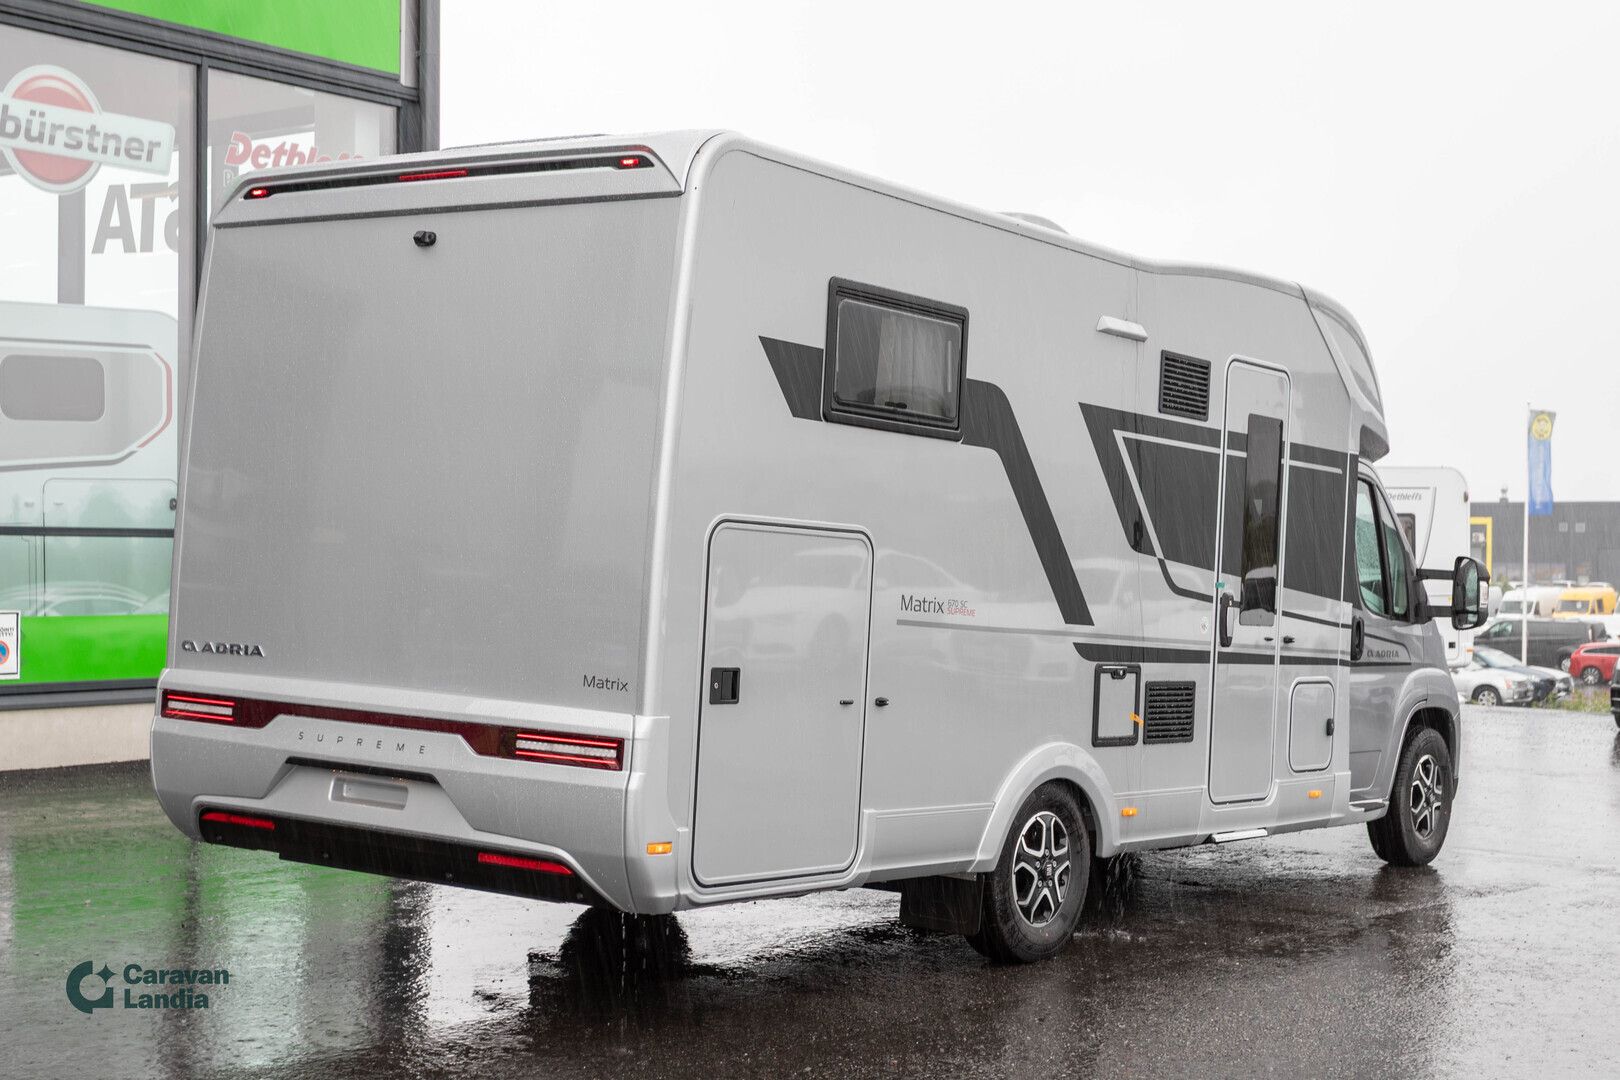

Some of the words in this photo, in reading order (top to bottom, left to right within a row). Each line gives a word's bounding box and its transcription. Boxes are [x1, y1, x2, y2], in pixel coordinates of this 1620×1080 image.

[0, 104, 161, 162] bürstner
[900, 594, 945, 613] Matrix
[946, 607, 976, 617] SUPREME
[202, 642, 264, 658] ADRIA
[583, 674, 628, 691] Matrix
[298, 731, 425, 754] SUPREME
